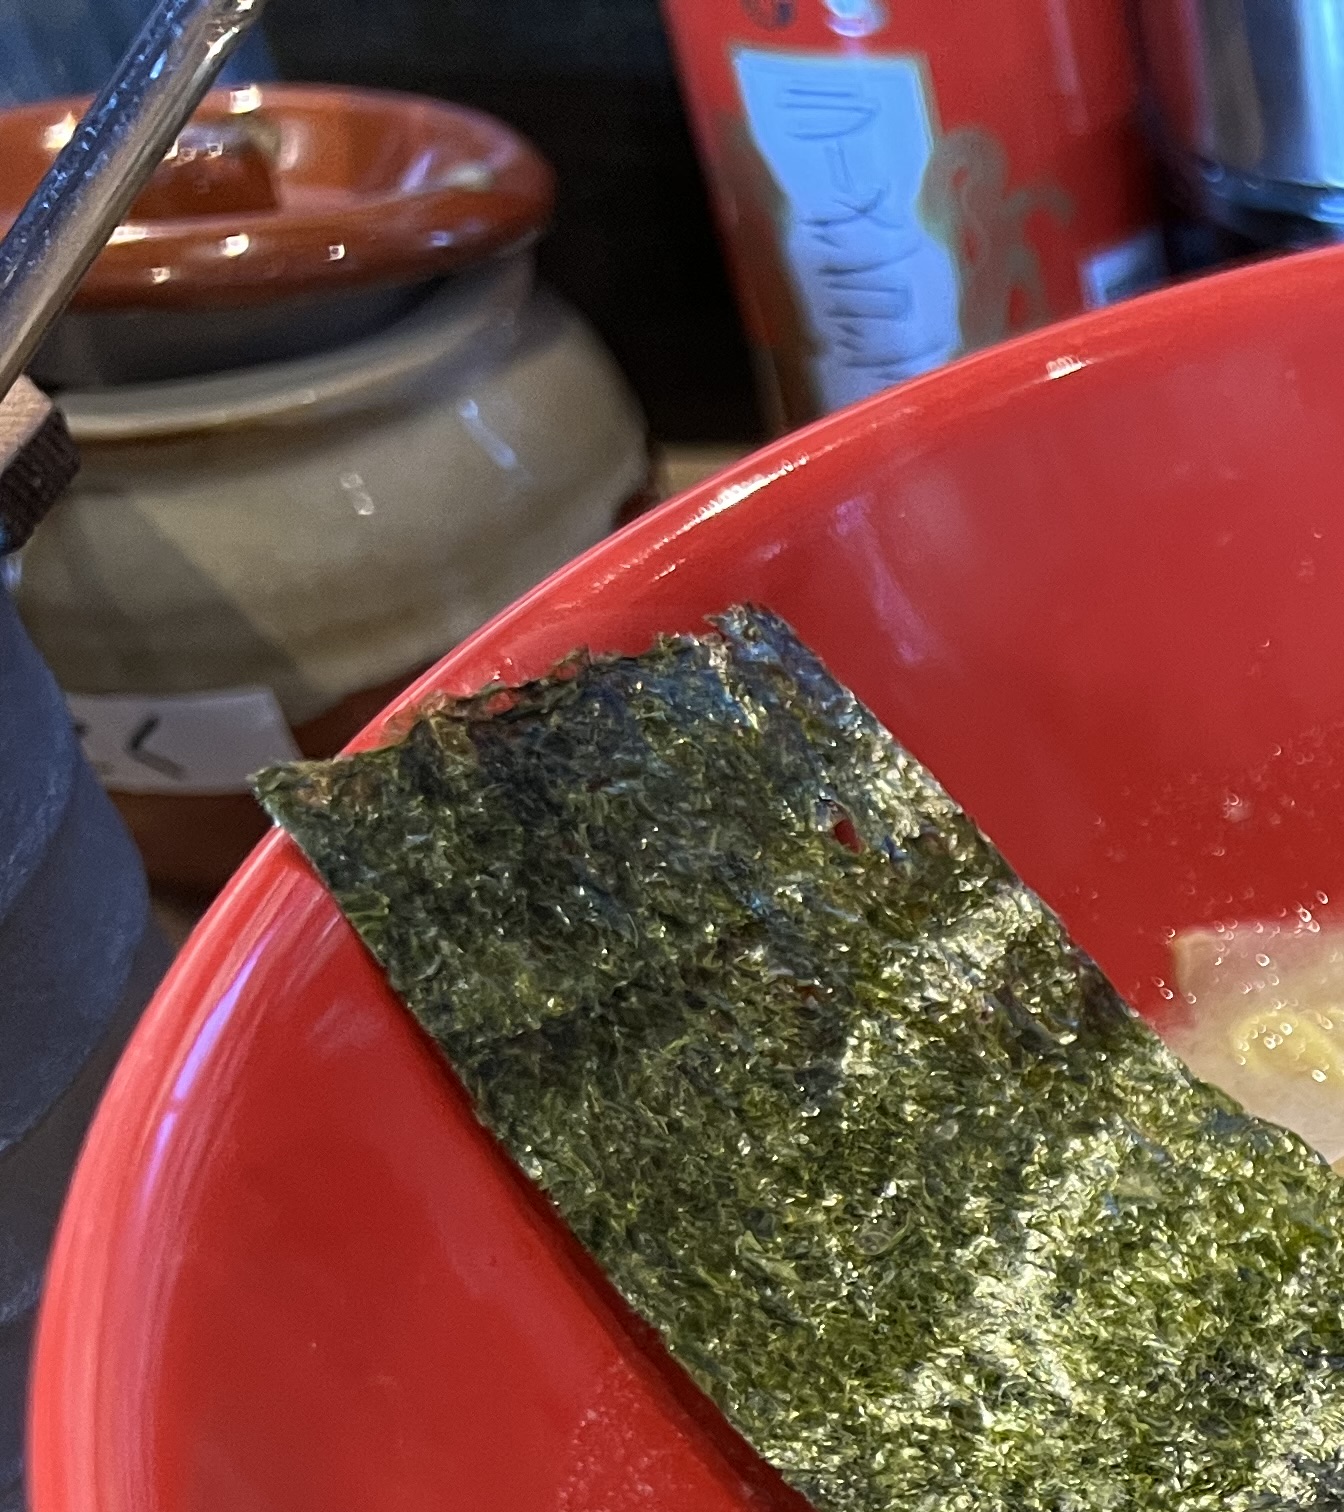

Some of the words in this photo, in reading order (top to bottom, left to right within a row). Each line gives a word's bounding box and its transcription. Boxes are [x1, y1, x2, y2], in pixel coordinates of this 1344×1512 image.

[775, 85, 945, 384] ラーメンコシ
